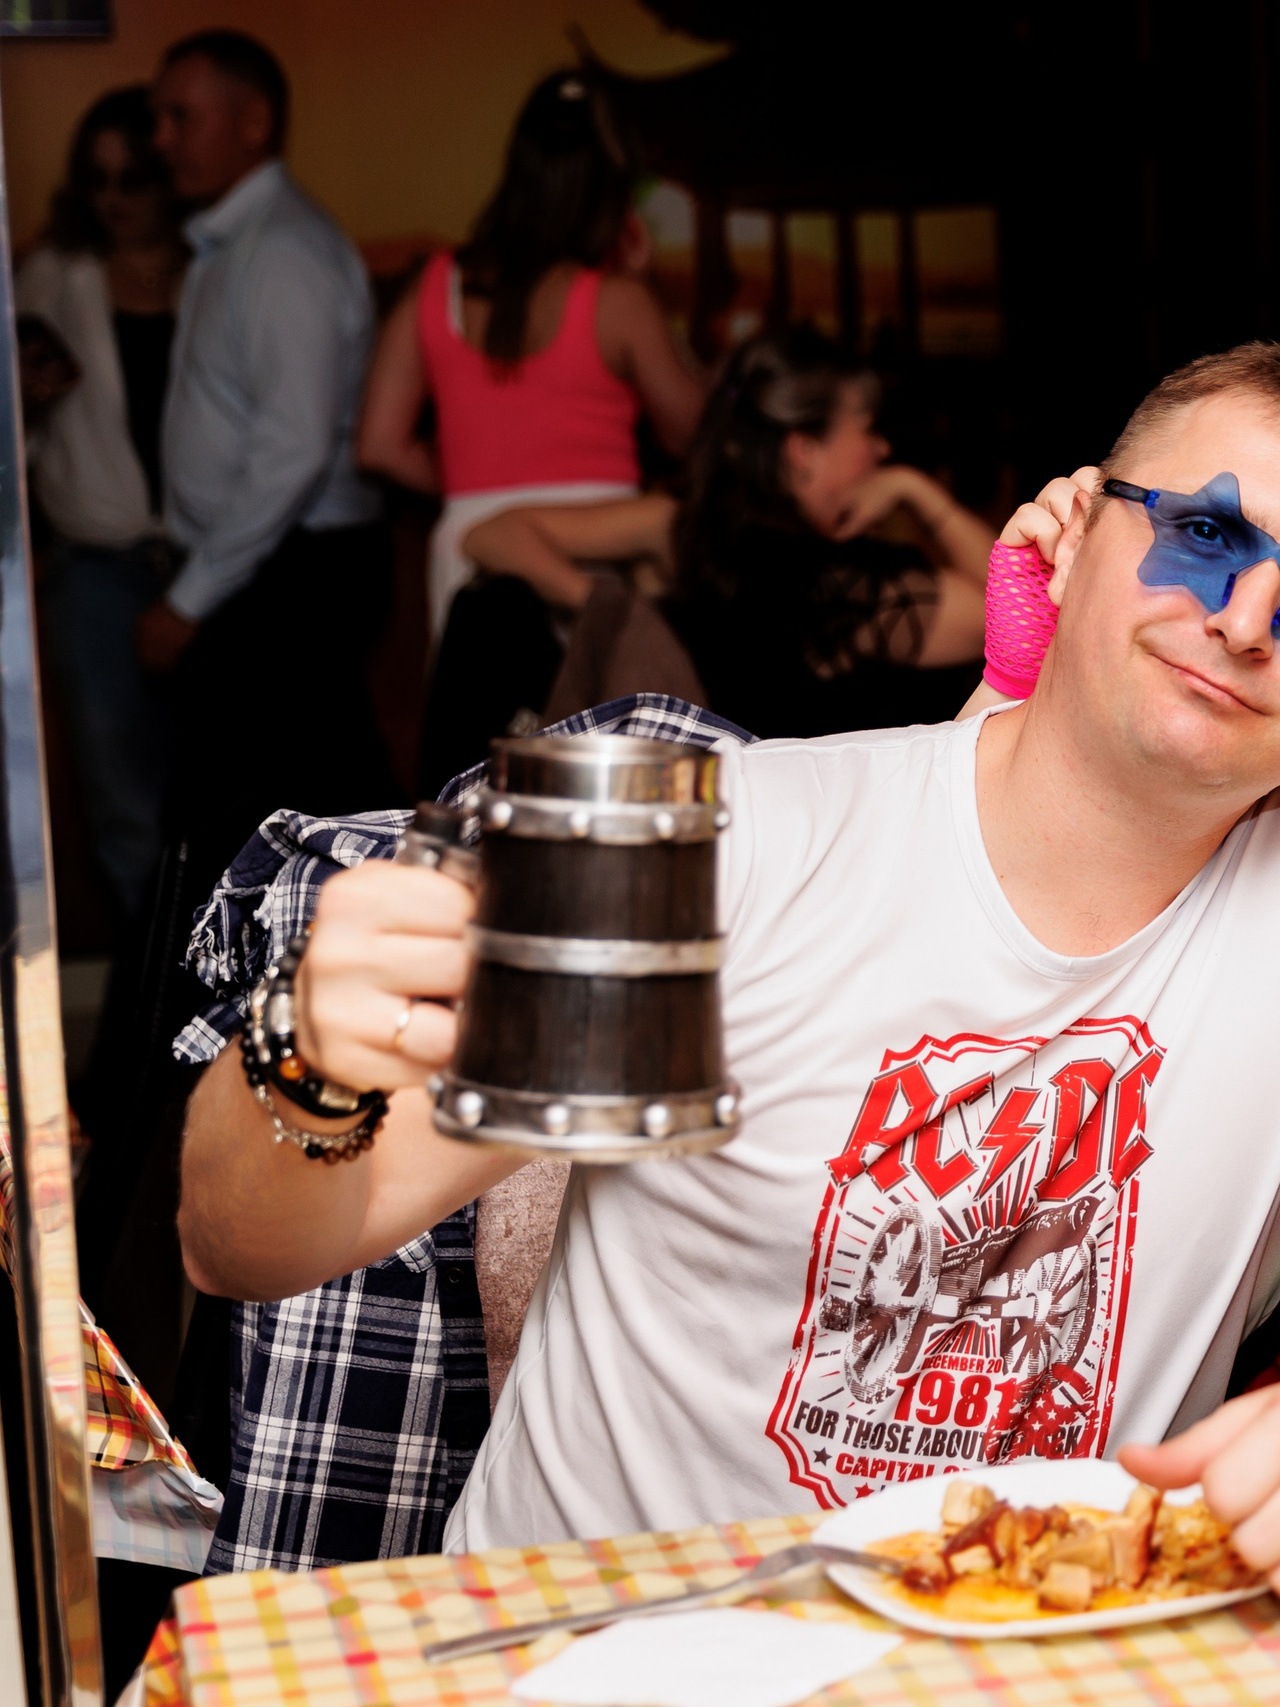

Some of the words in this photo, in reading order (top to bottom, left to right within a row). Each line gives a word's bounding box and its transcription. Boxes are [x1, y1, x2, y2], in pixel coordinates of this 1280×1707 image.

[921, 1353, 985, 1374] DECEMBER
[893, 1370, 1018, 1431] 1981
[793, 1400, 840, 1440] FOR
[842, 1414, 915, 1454] THOSE
[914, 1427, 987, 1463] ABOUT
